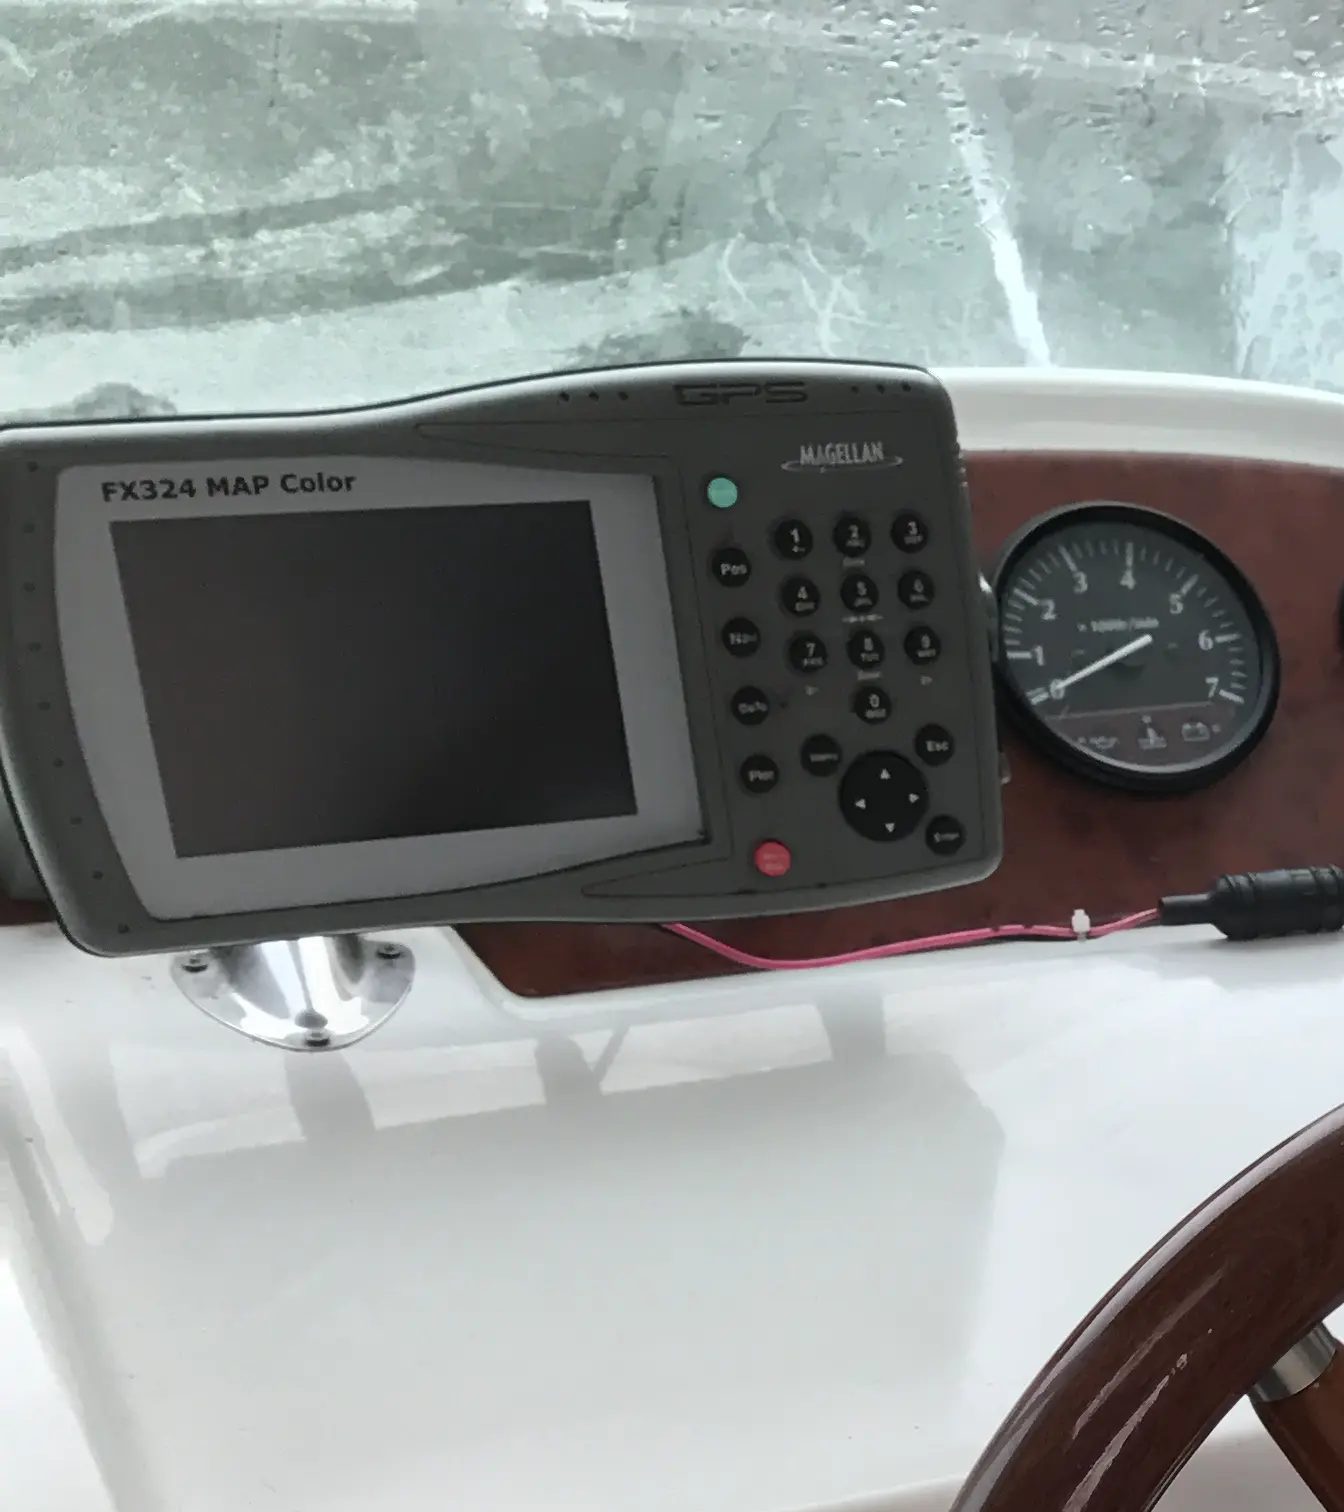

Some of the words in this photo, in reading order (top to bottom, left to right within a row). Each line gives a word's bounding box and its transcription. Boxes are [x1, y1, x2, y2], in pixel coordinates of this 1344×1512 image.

[672, 381, 808, 406] GPS
[800, 442, 884, 465] MAGELLAN
[101, 478, 196, 502] FX324
[206, 474, 269, 497] MAP
[280, 471, 356, 494] Color
[908, 521, 918, 535] 3
[1073, 571, 1088, 594] 3
[1120, 568, 1137, 590] 4
[797, 586, 808, 600] 4
[1169, 593, 1184, 615] 5
[1041, 599, 1058, 621] 2
[805, 641, 816, 656] 7
[1198, 630, 1214, 651] 6
[1035, 645, 1046, 667] 1
[1205, 677, 1219, 698] 7
[925, 740, 949, 752] Esc
